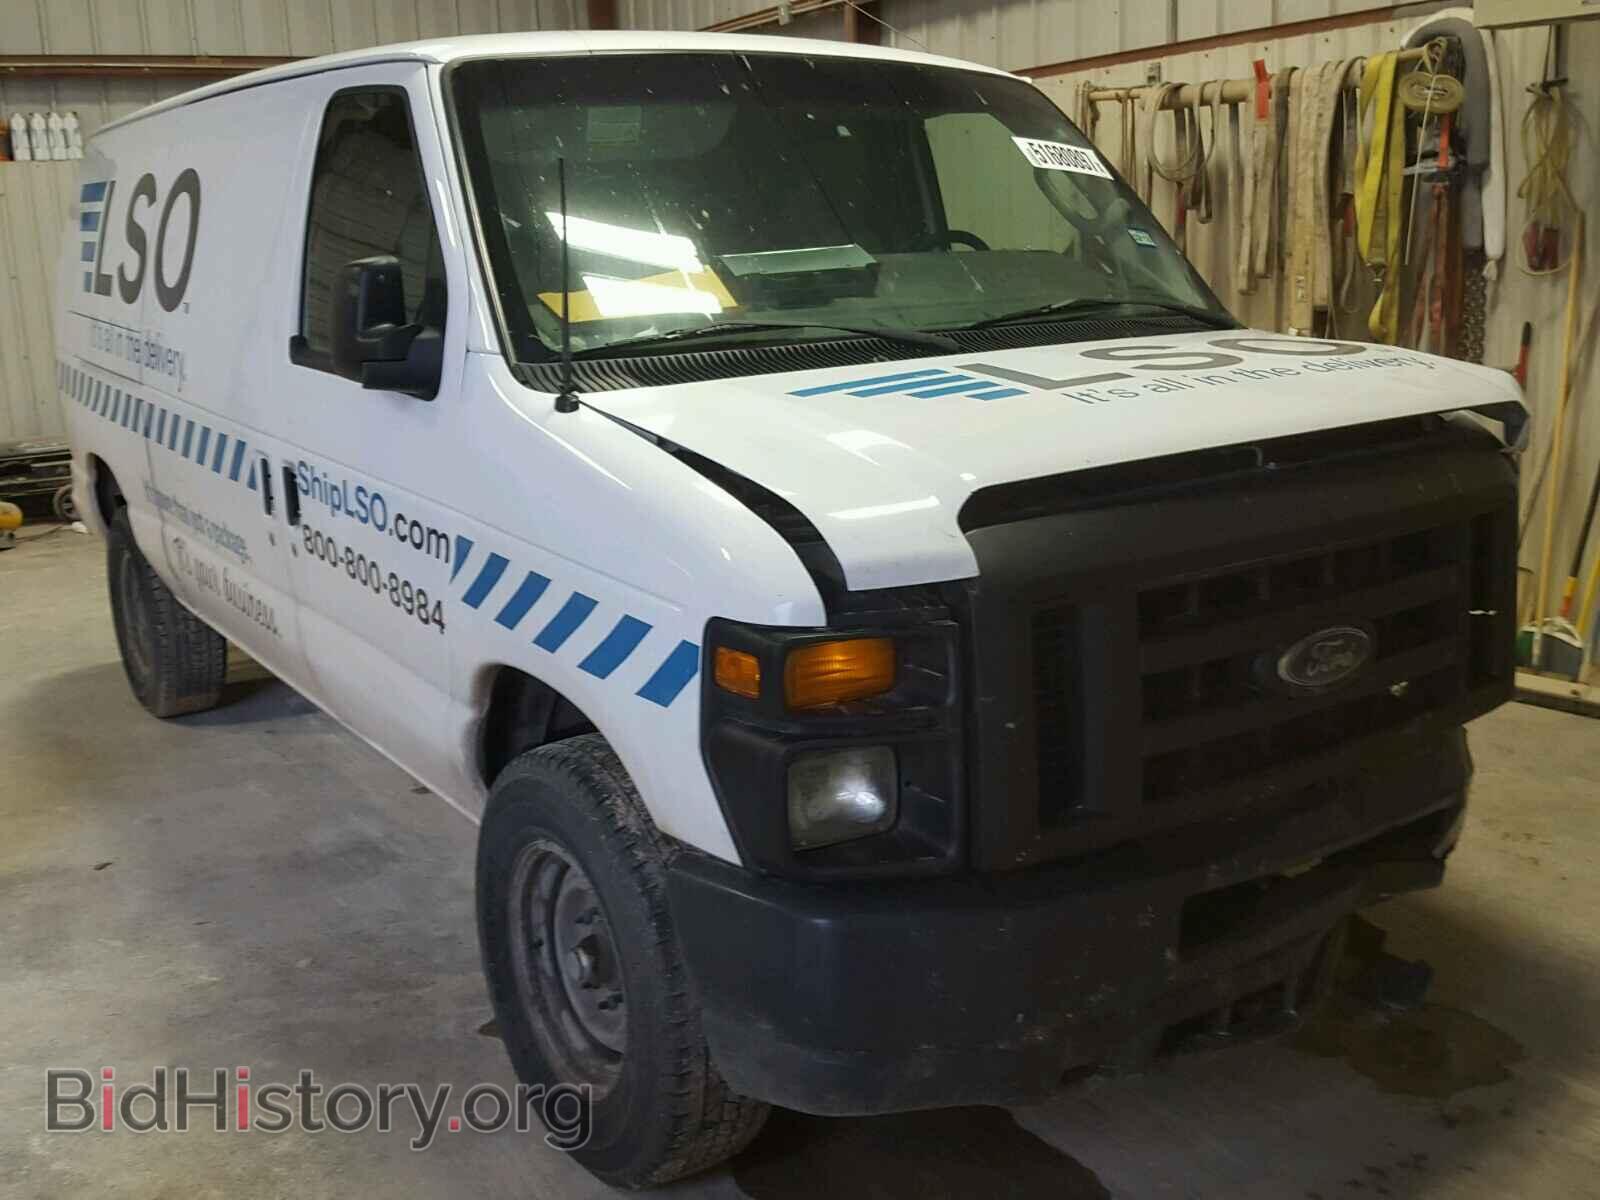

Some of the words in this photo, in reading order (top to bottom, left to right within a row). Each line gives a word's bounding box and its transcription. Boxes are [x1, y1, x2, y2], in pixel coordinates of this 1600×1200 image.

[93, 167, 201, 312] LSO
[953, 337, 1367, 391] LSO
[1061, 387, 1140, 404] It's
[1142, 377, 1195, 393] all
[1182, 374, 1238, 386] in
[1230, 366, 1301, 380] the
[297, 459, 450, 564] ShipLSO.com
[302, 524, 447, 634] 800-800-8984
